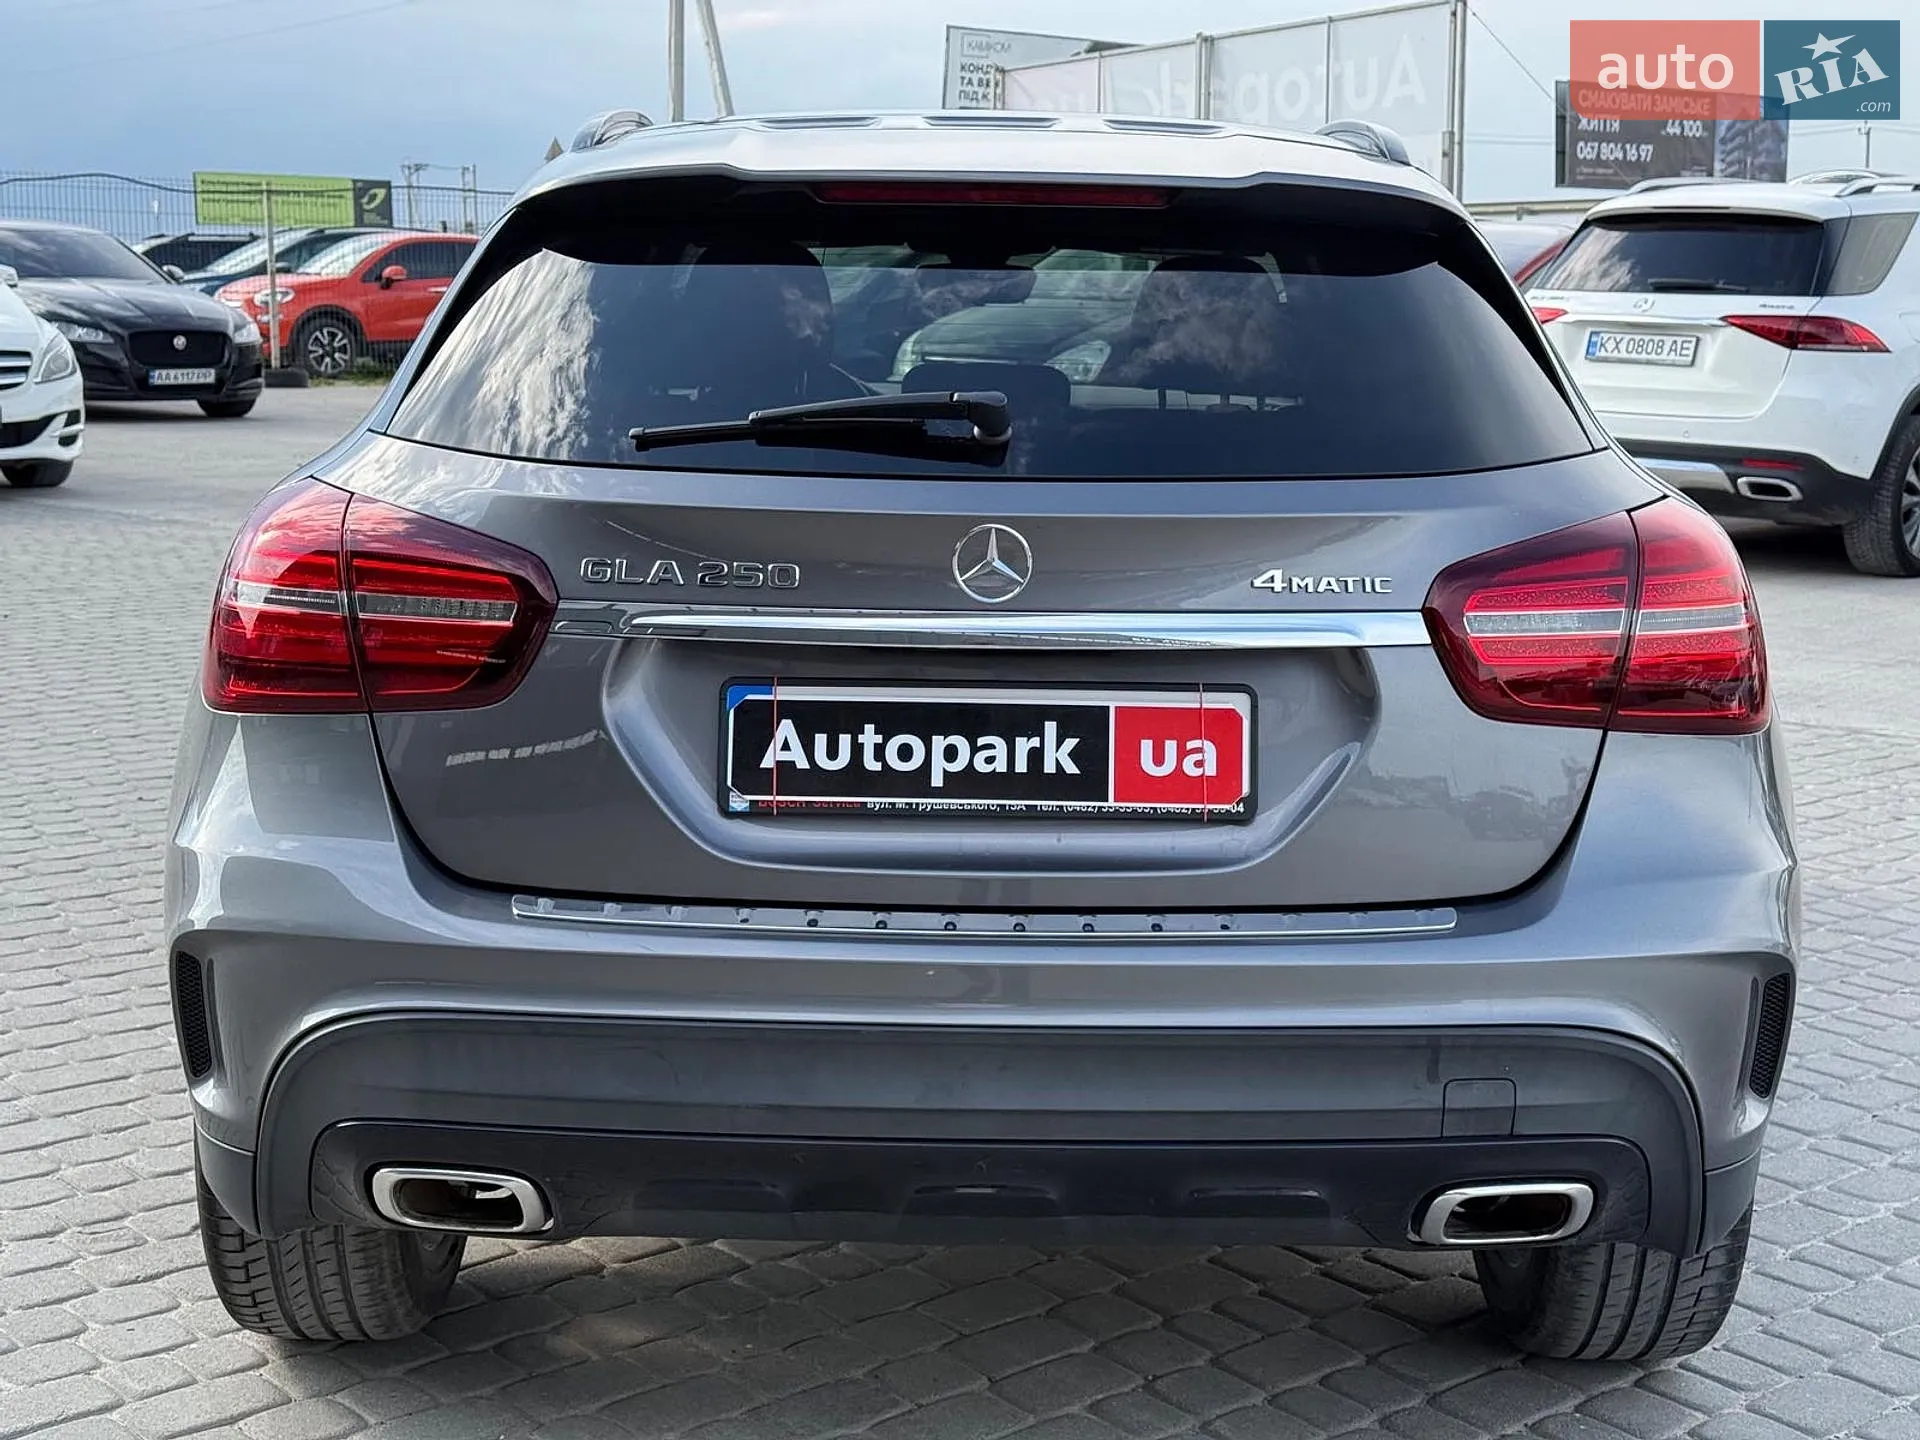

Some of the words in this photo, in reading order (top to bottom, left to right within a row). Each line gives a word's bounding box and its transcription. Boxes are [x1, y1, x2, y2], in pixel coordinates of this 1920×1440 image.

[960, 76, 975, 87] ТА
[1576, 141, 1598, 160] 067
[1600, 142, 1623, 161] 804
[1625, 143, 1638, 162] 16
[1639, 144, 1654, 162] 97
[1599, 336, 1624, 354] KX
[1625, 337, 1665, 356] 0808
[1667, 339, 1693, 357] AE
[580, 557, 684, 586] GLA
[697, 561, 800, 589] 250
[1251, 568, 1393, 593] 4MATIC
[759, 718, 1081, 787] Autopark
[1139, 737, 1217, 777] ua
